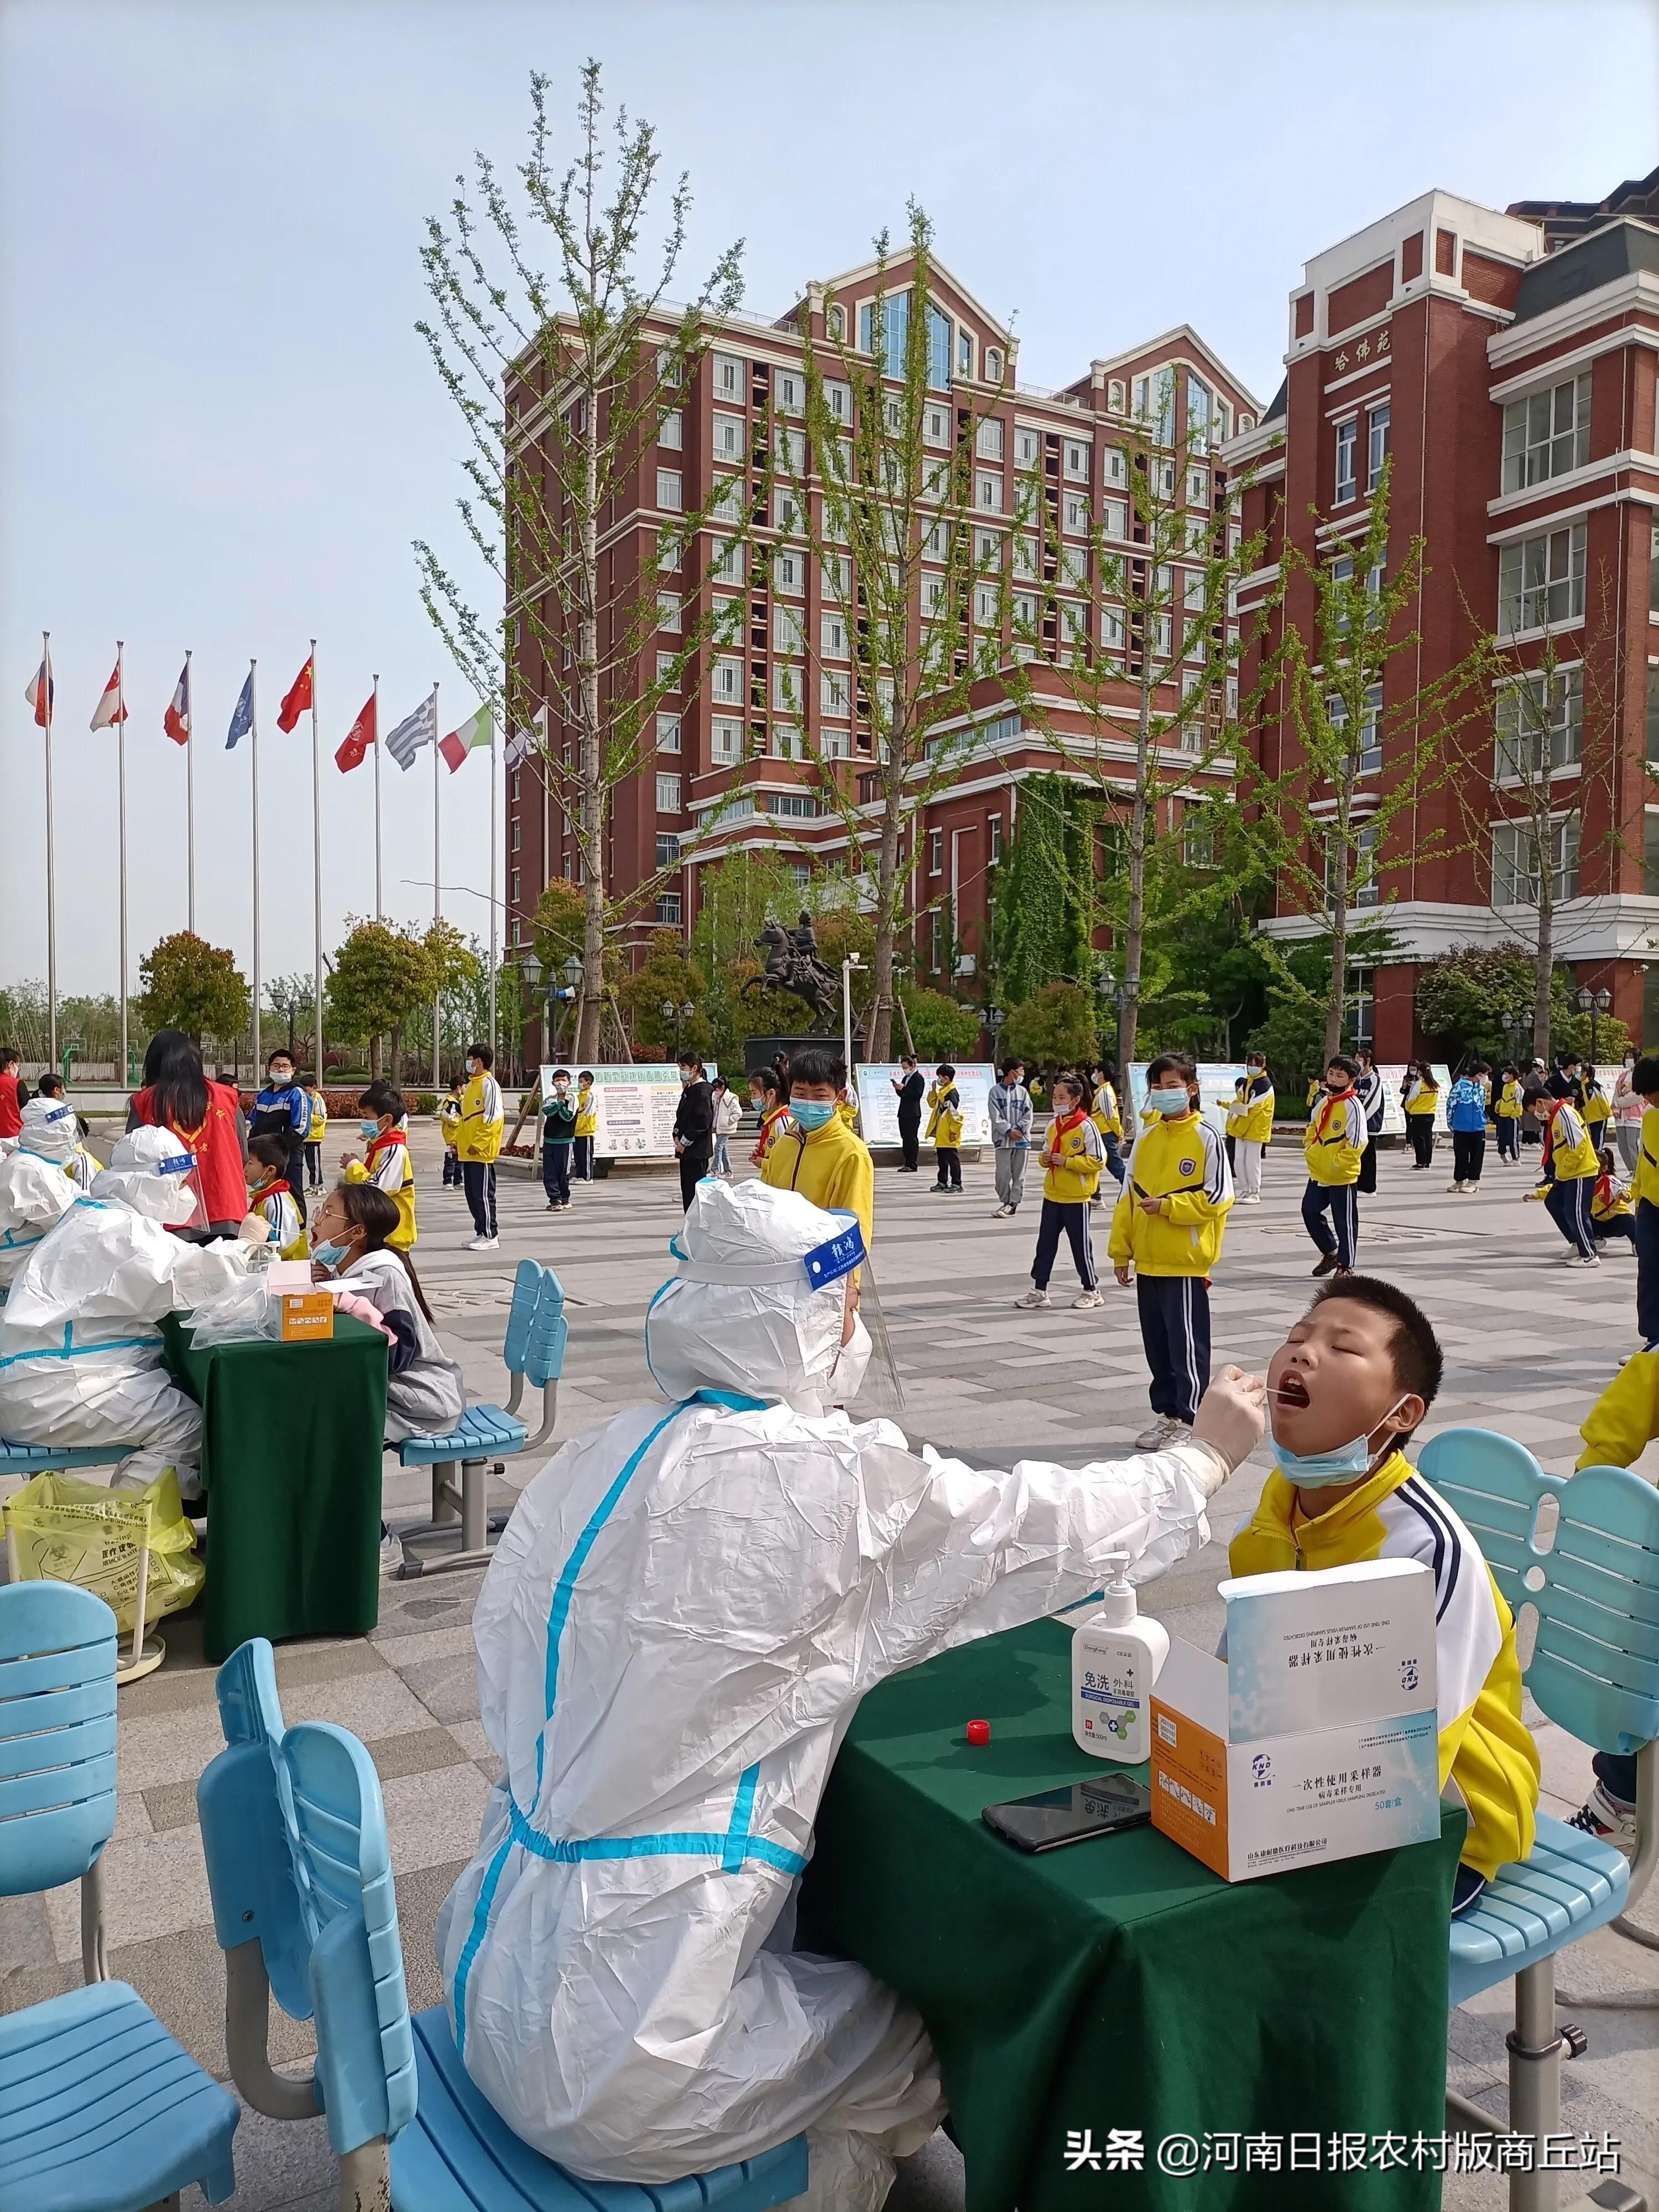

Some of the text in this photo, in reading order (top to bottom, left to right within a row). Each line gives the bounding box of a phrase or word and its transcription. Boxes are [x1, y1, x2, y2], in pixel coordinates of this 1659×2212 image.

[1335, 330, 1391, 372] 哈佛苑
[1288, 1643, 1385, 1668] 一次性使用采样器
[1085, 1671, 1109, 1691] 免洗
[1113, 1678, 1134, 1689] 外科
[1252, 1762, 1271, 1770] KND
[1292, 1765, 1381, 1791] 一次性使用采样器
[1375, 1797, 1402, 1810] 50套/盒
